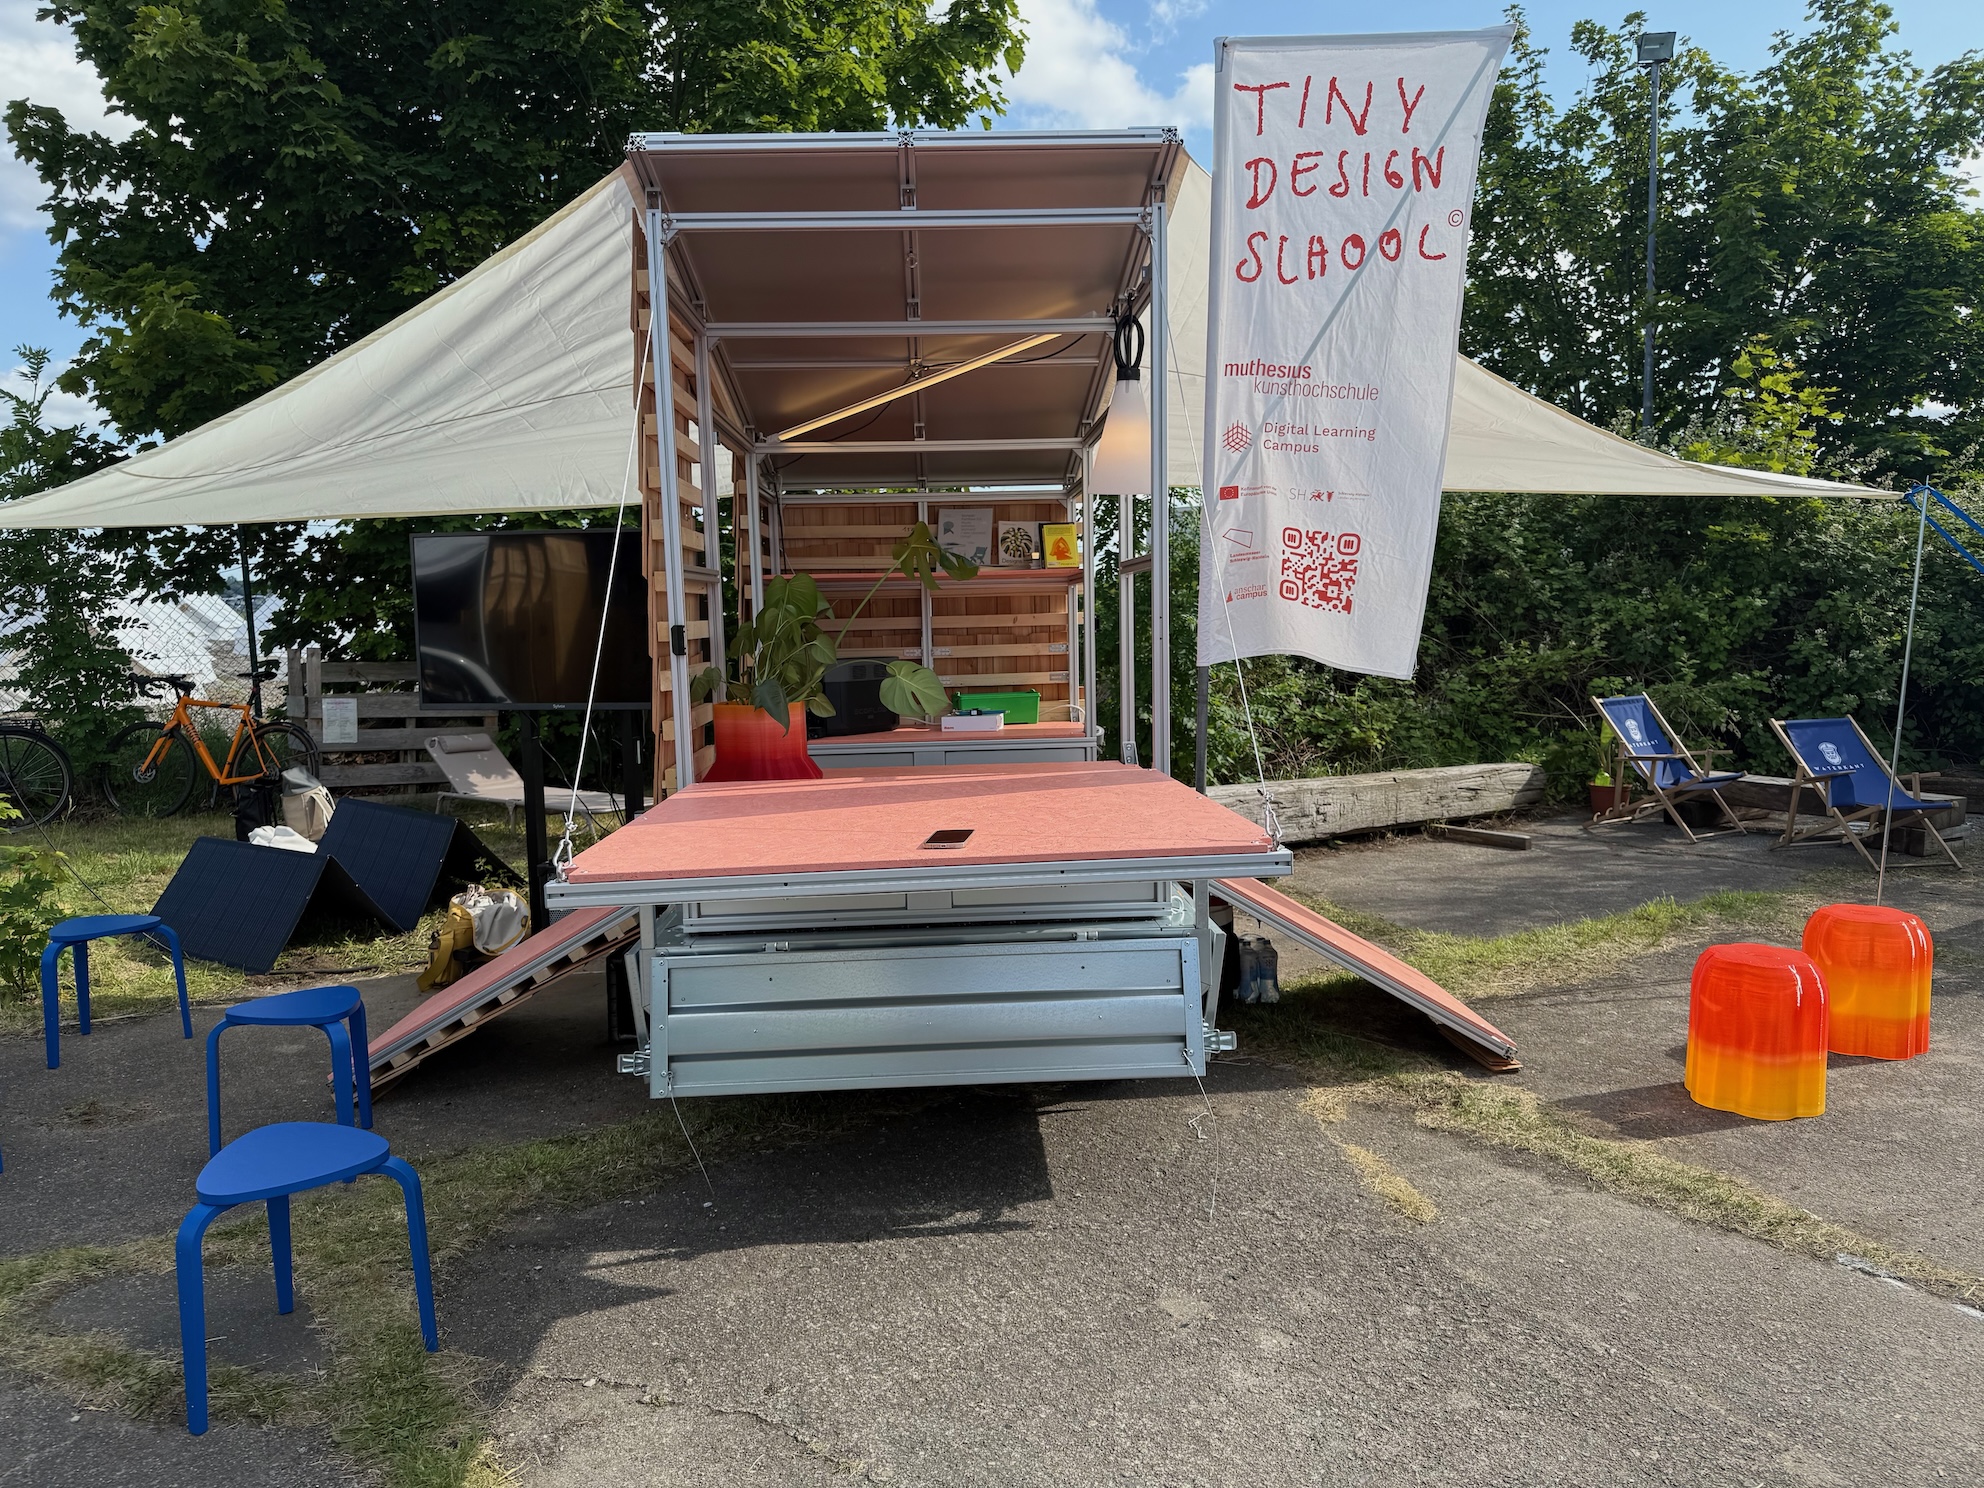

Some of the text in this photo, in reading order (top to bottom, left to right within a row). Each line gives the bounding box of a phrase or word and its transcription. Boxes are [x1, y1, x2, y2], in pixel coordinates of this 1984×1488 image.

[1234, 75, 1425, 136] TINY
[1245, 146, 1445, 209] DESIGN
[1236, 223, 1447, 285] SCHOOL
[1224, 358, 1312, 379] muthesius
[1253, 377, 1379, 401] kunsthochschule
[1264, 422, 1377, 441] Digital Learning
[1263, 439, 1320, 455] Campus
[1289, 487, 1307, 501] SH
[1234, 584, 1267, 595] anschar
[1236, 590, 1268, 600] campus
[1629, 739, 1659, 748] ATERKANT
[1813, 763, 1865, 771] WATERKANT
